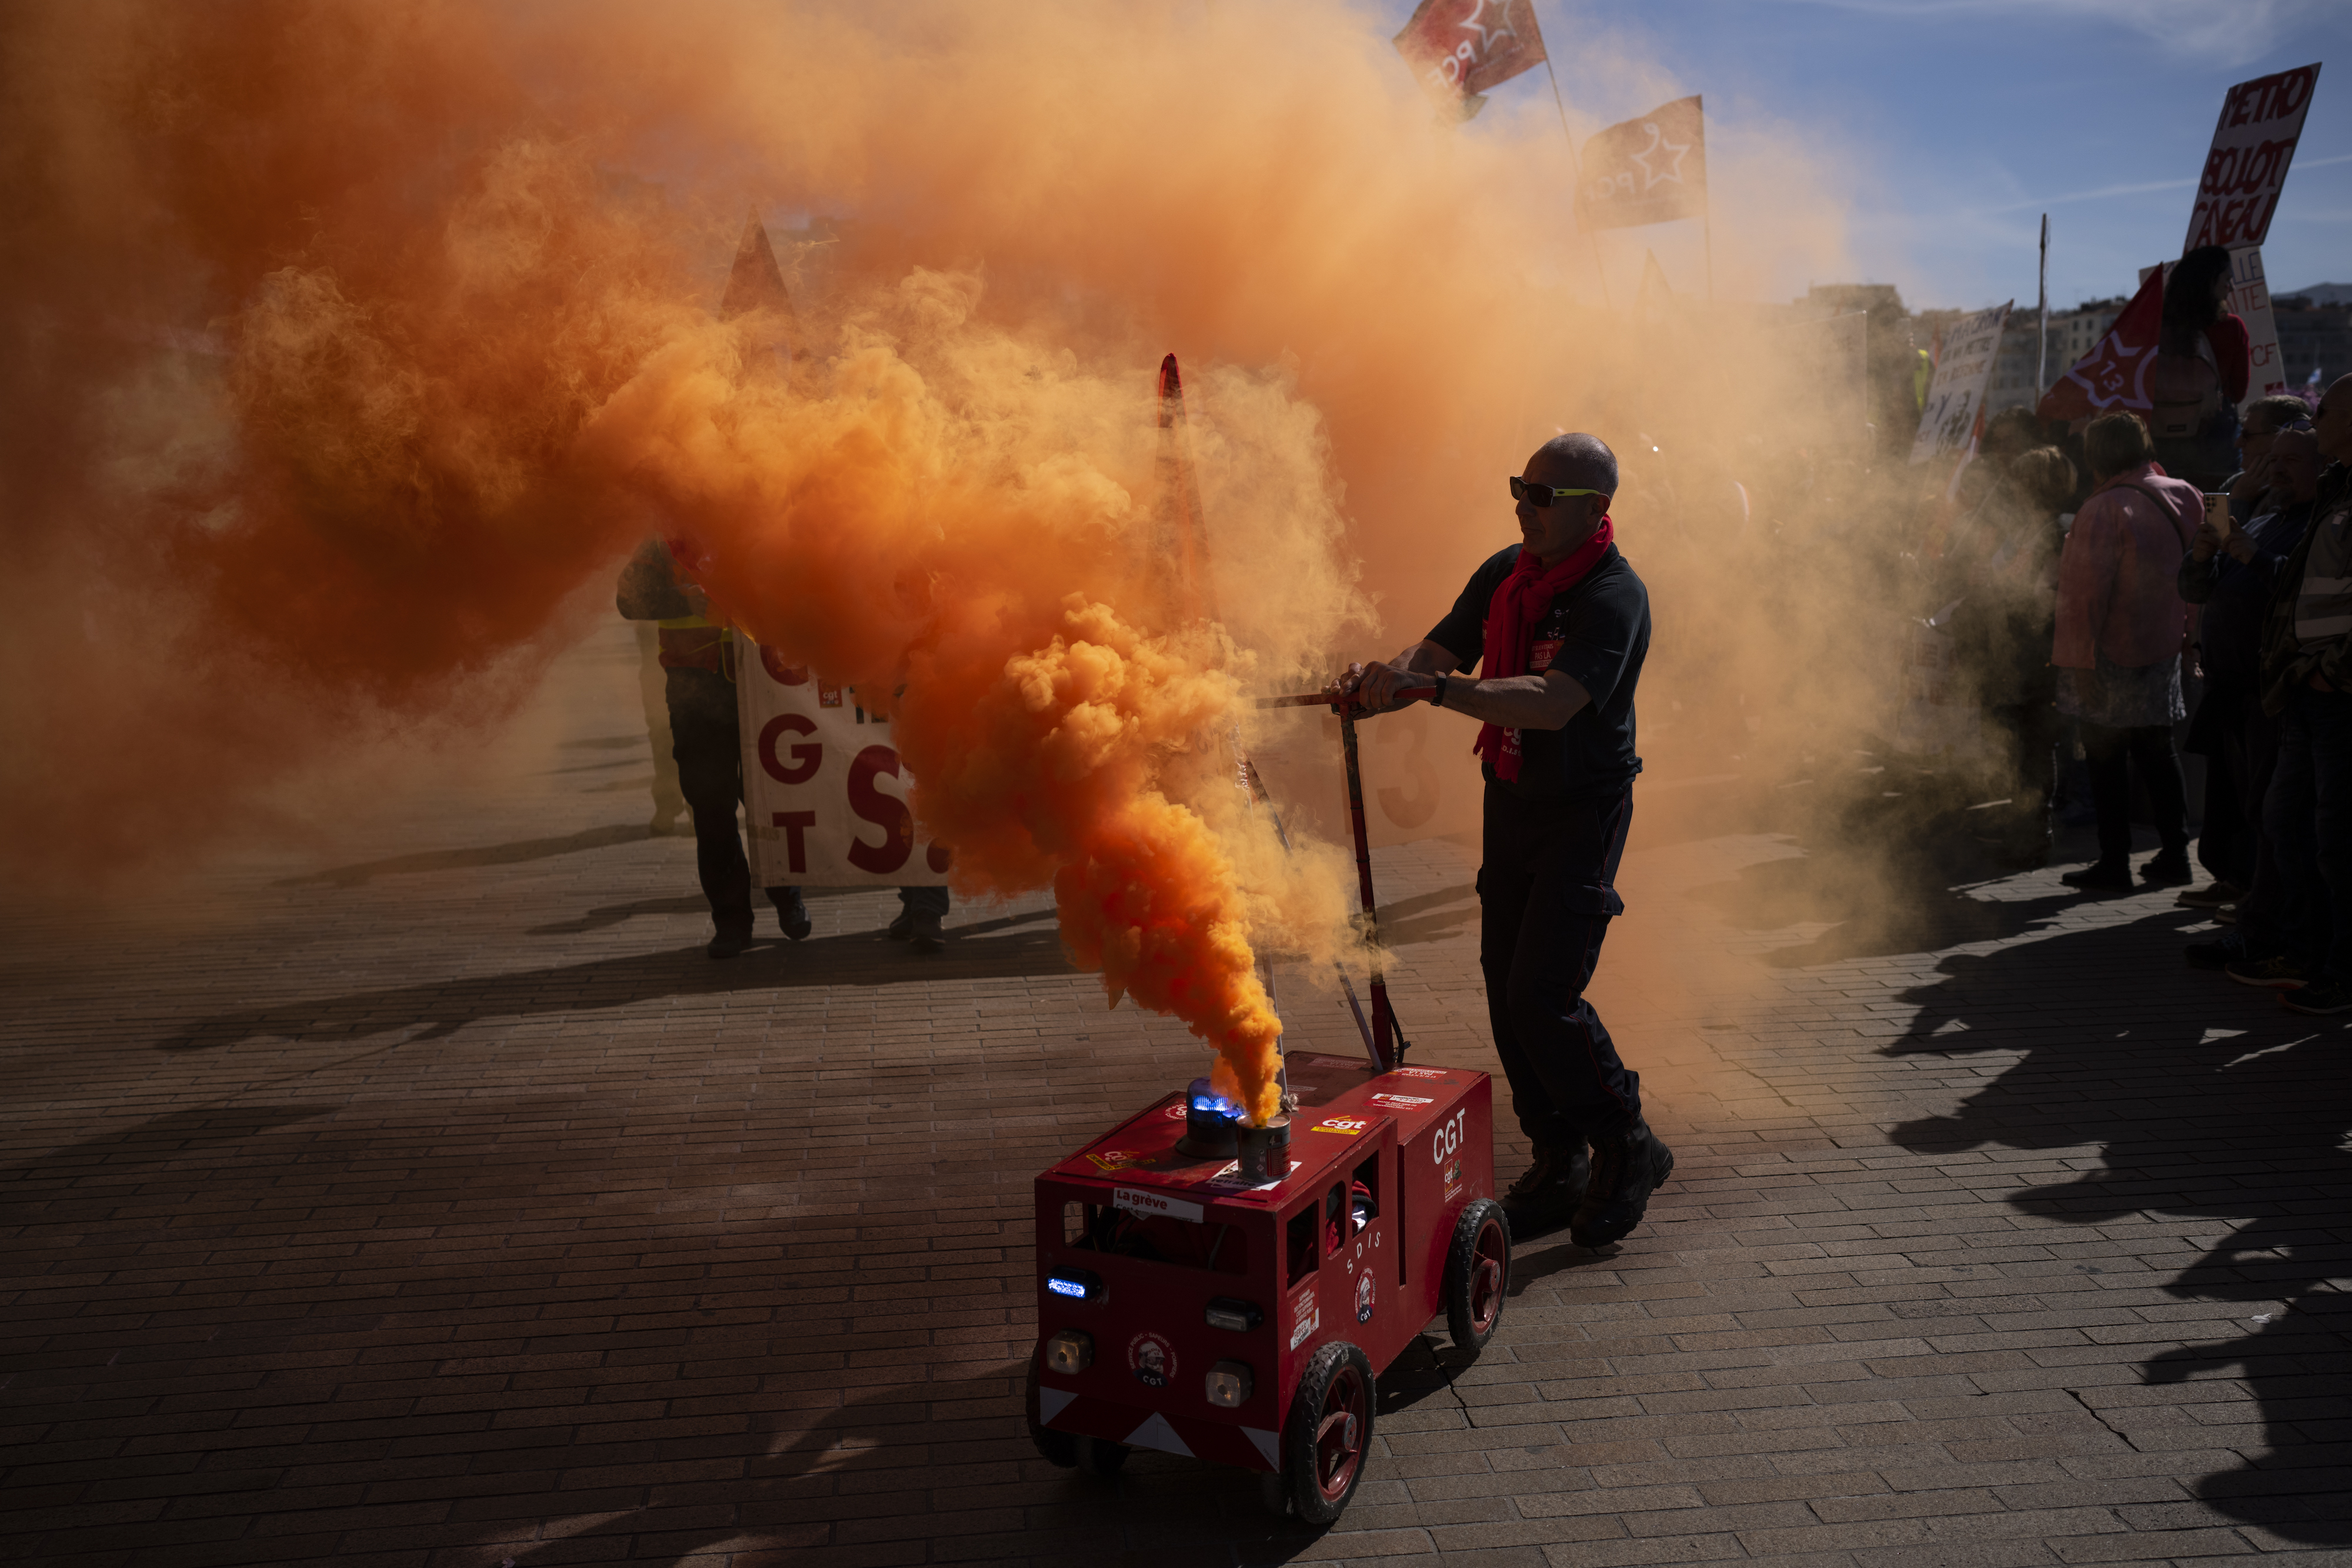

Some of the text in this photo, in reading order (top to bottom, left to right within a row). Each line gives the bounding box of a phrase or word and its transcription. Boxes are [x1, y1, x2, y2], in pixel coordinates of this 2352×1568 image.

[1535, 648, 1551, 660] PAS LÀ
[823, 690, 837, 701] cgt
[1504, 727, 1522, 745] cg
[1322, 1119, 1367, 1129] cgt
[1269, 1135, 1275, 1145] 4
[1434, 1108, 1465, 1165] CGT
[1210, 1178, 1256, 1186] retraite
[1117, 1189, 1168, 1211] La grève
[1360, 1309, 1371, 1321] CGT
[1128, 1332, 1177, 1378] SERVICE PUBLIC SAPEURS POMPIERS
[1143, 1375, 1162, 1385] CGT
